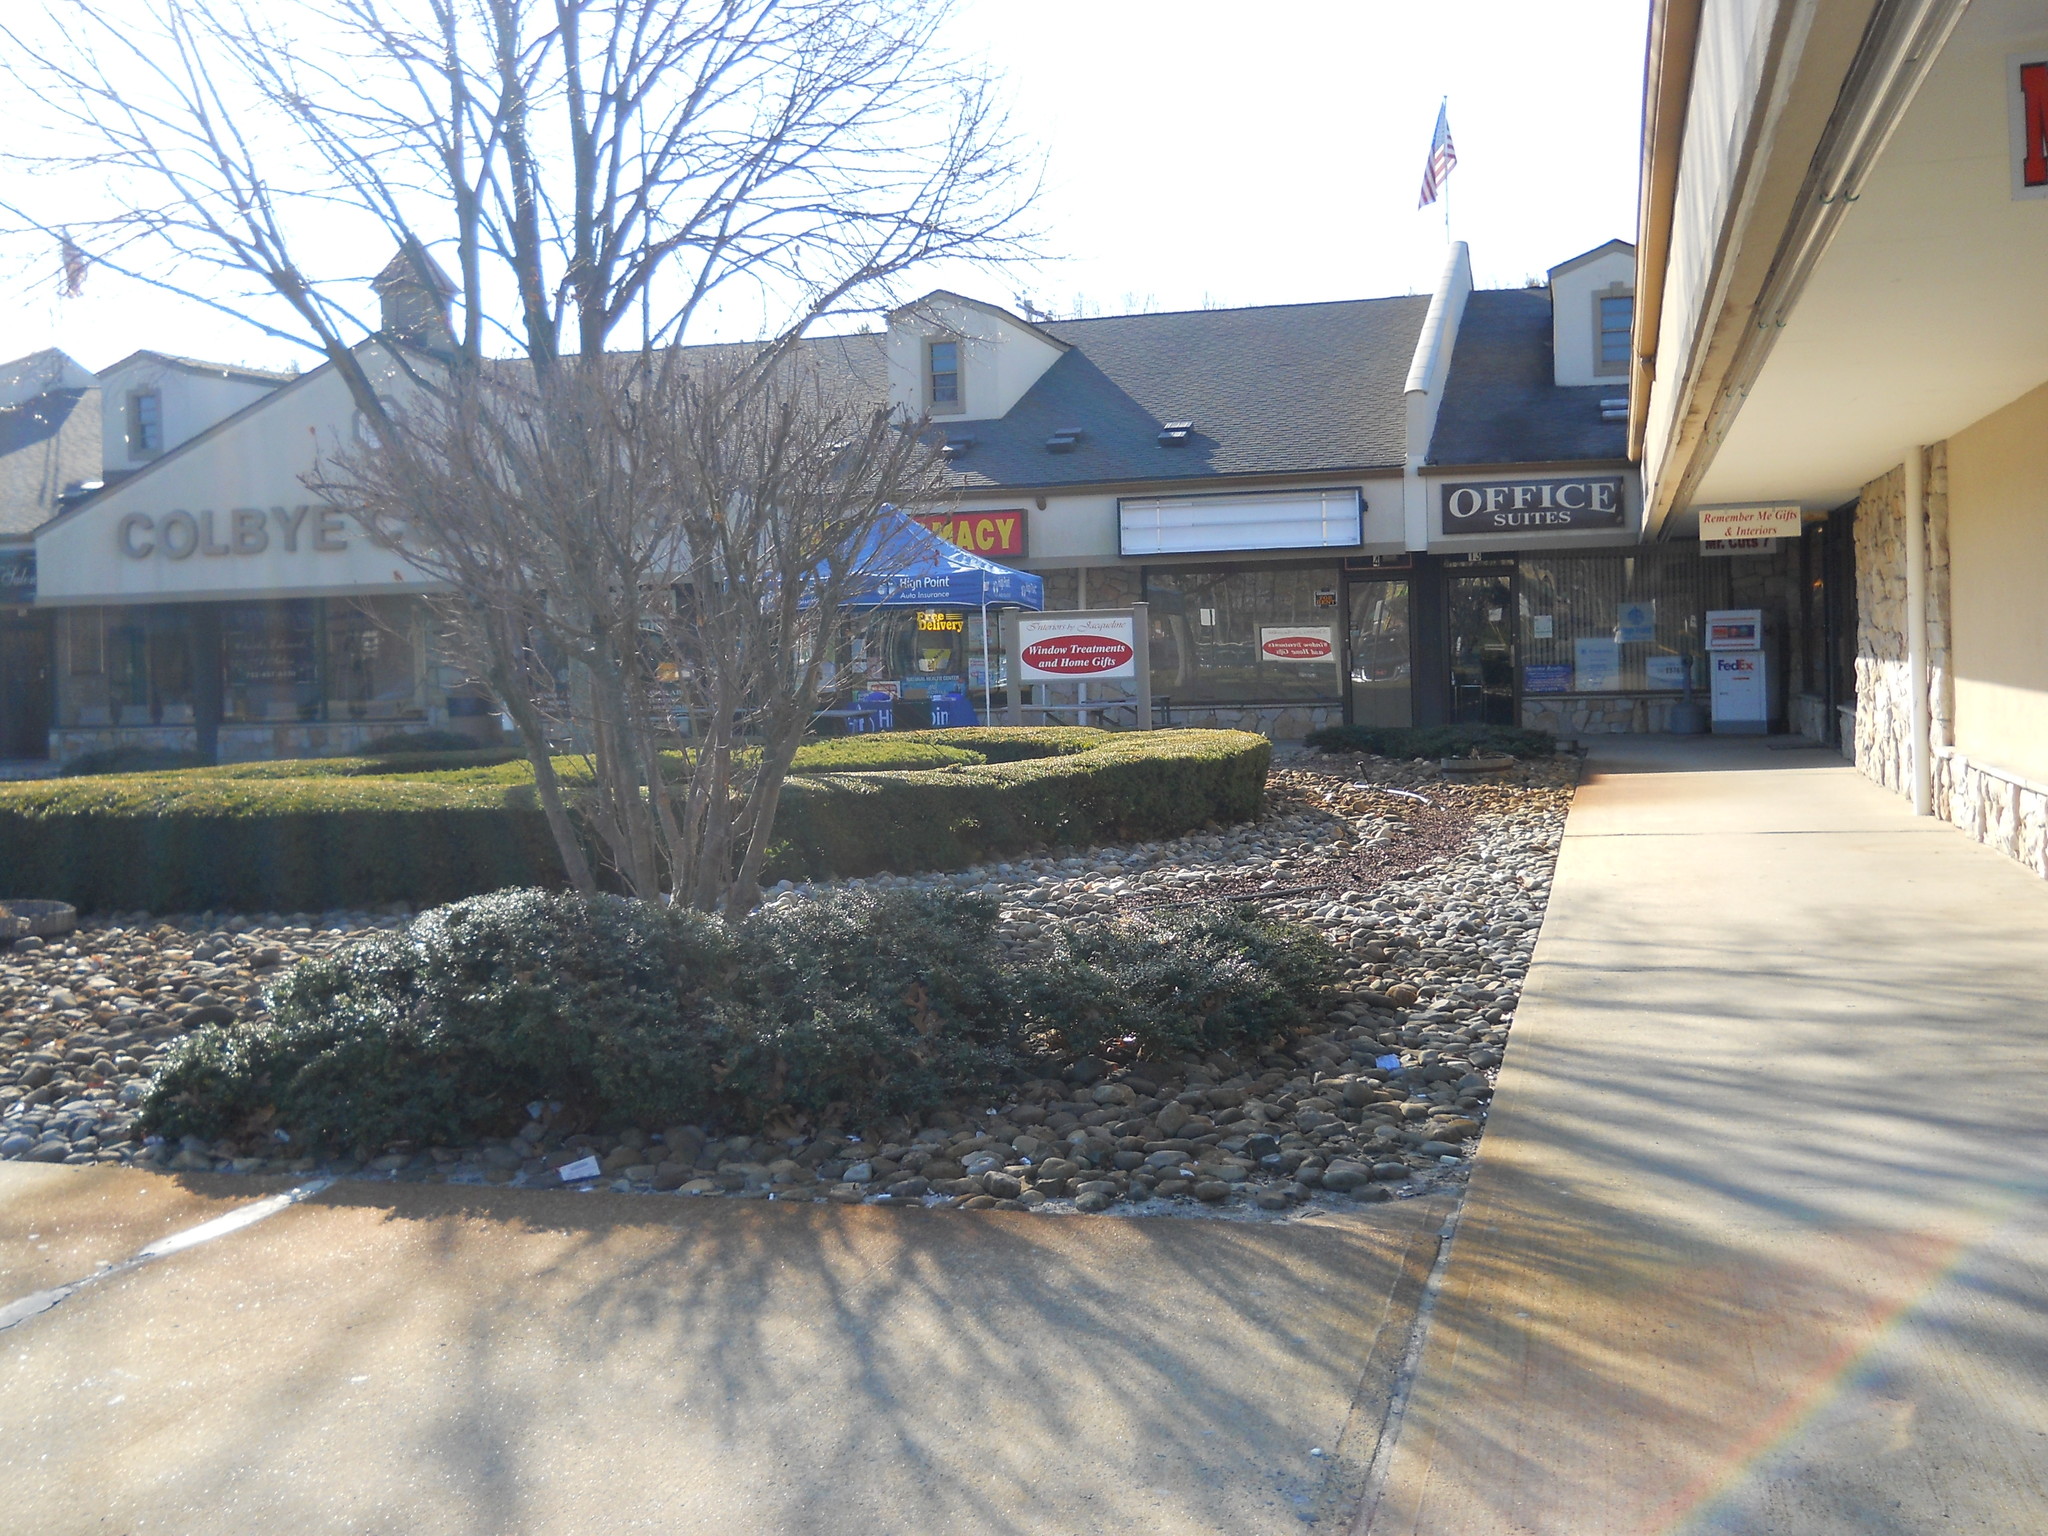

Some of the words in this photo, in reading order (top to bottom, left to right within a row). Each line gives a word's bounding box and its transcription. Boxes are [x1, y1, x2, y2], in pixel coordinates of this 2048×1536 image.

[1449, 483, 1616, 518] OFFICE
[1494, 511, 1571, 526] SUITES
[1704, 511, 1754, 523] Remember
[1757, 511, 1772, 521] Me
[1775, 510, 1797, 521] Gifts
[116, 505, 348, 560] COLBYE
[921, 518, 1015, 550] MACY
[1724, 527, 1732, 536] &
[1736, 525, 1777, 536] Interiors
[924, 576, 949, 588] Point
[917, 612, 945, 621] Free
[918, 620, 964, 632] Delivery
[1026, 622, 1066, 631] Interiors
[1077, 620, 1126, 632] Jacqueline
[1029, 646, 1067, 655] Window
[1070, 644, 1125, 654] Treatments
[1038, 659, 1058, 668] and
[1060, 658, 1089, 667] Home
[1092, 656, 1116, 668] Gifts
[1718, 659, 1753, 671] FedEx
